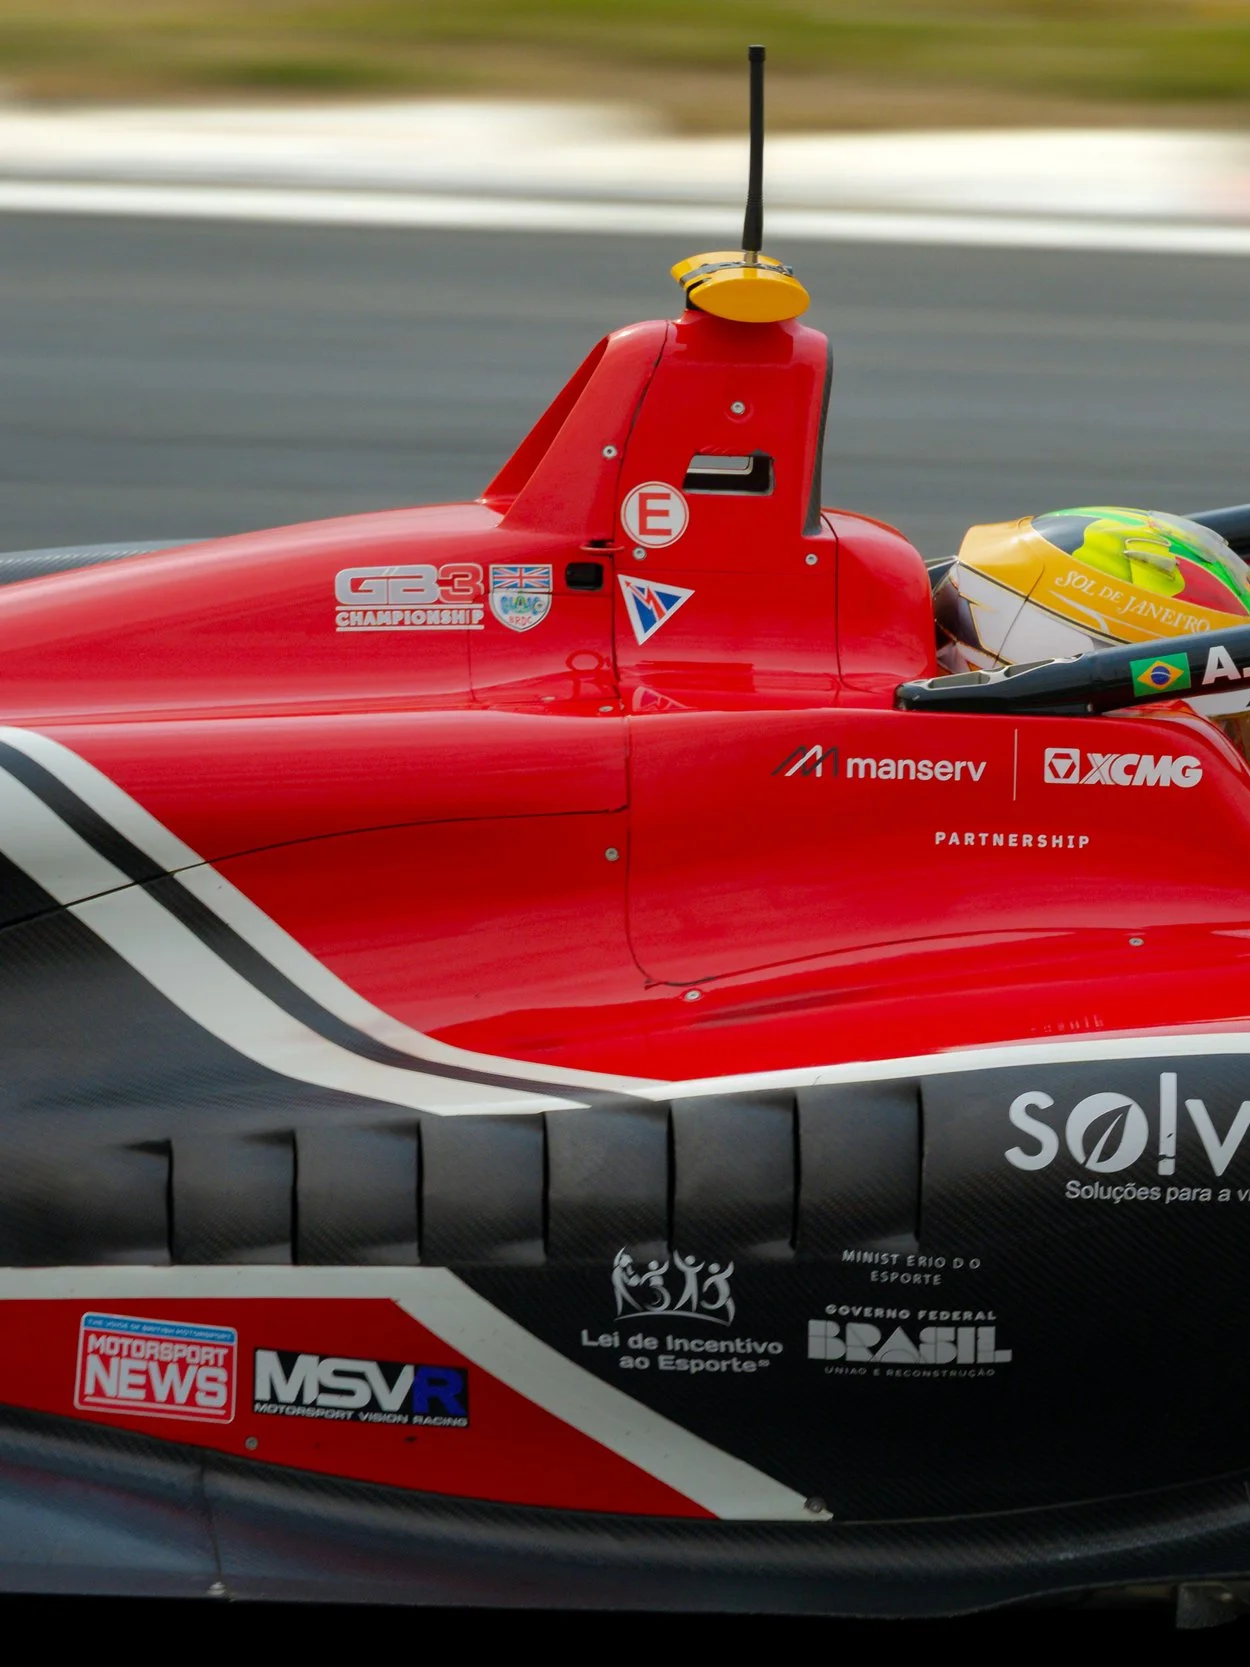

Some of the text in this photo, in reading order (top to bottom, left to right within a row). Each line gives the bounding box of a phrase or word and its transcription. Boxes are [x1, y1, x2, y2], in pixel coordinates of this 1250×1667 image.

[638, 492, 672, 536] E
[335, 562, 485, 604] GB3
[1055, 570, 1211, 633] SOL DE JANEIRO
[335, 609, 485, 627] CHAMPIONSHIP
[846, 757, 988, 782] manserv
[1079, 752, 1203, 788] XCMG
[934, 831, 1090, 849] PARTNERSHIP
[1065, 1179, 1162, 1205] Soluções
[1166, 1186, 1213, 1205] para
[1218, 1188, 1231, 1203] a
[870, 1270, 942, 1286] ESPORTE
[825, 1303, 997, 1321] GOVERNO FEDERAL
[87, 1333, 229, 1367] MOTORSPORT
[581, 1328, 784, 1355] Lei de Incentivo
[807, 1319, 1013, 1364] BRASIL
[619, 1355, 651, 1370] ao
[873, 1367, 881, 1377] E
[84, 1354, 228, 1408] NEWS
[254, 1349, 468, 1416] MSVR
[254, 1402, 468, 1428] MOTORSPORT VISION RACING
